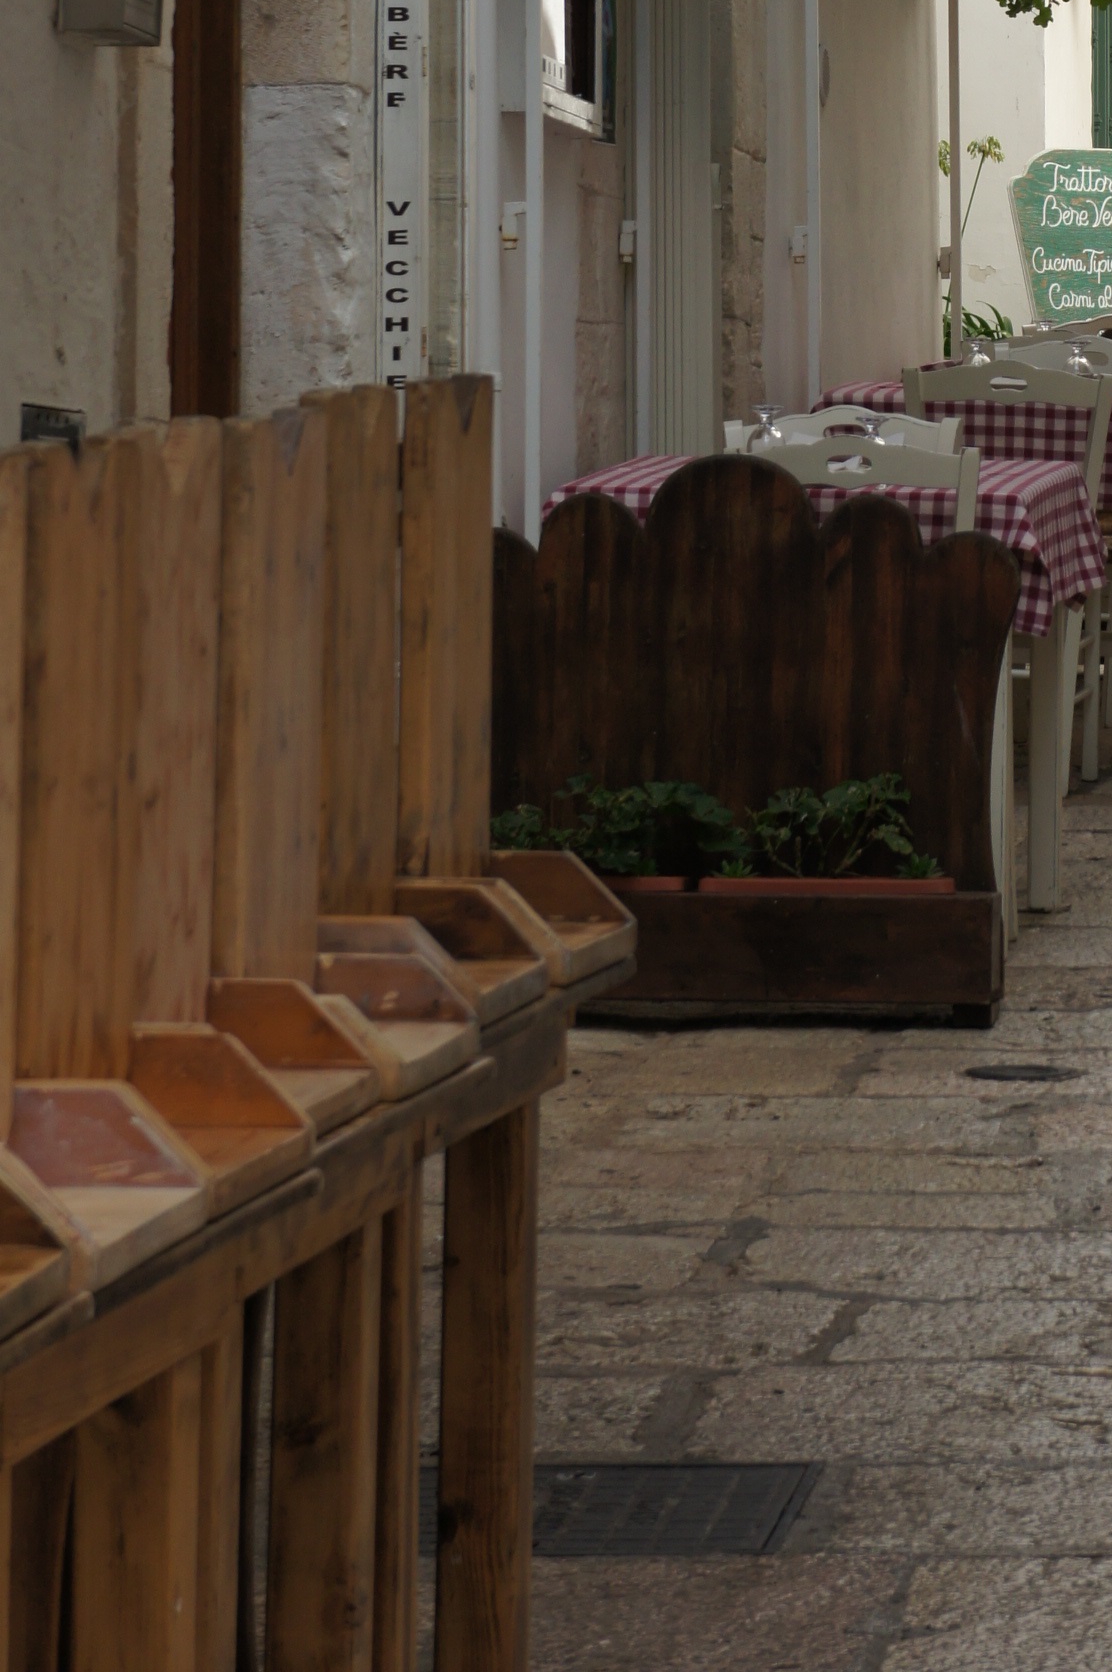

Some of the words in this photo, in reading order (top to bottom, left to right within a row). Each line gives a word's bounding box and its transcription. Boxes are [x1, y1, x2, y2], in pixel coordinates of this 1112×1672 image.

[1032, 247, 1087, 274] Cucina
[385, 201, 411, 390] VECCHIE
[1048, 283, 1096, 310] Carni
